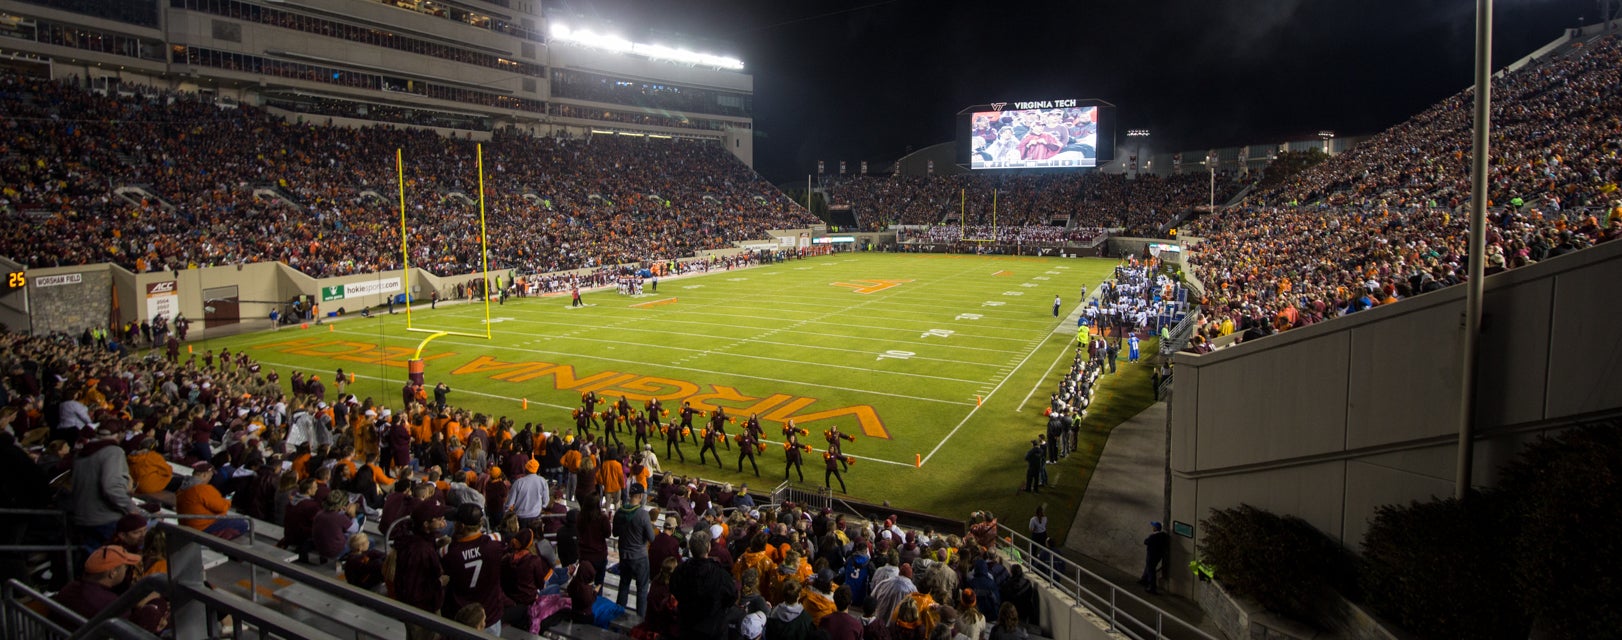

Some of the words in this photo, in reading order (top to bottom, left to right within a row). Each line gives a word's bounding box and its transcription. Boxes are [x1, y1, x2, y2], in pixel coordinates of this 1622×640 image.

[1014, 101, 1053, 110] VIRGINIA
[1054, 99, 1077, 108] TECH
[9, 271, 26, 288] 25
[37, 275, 65, 286] WORSHAM
[66, 274, 80, 283] FIELD
[150, 281, 174, 293] ACC
[347, 281, 398, 295] hokiesports.com
[876, 350, 916, 361] 10
[449, 355, 894, 440] VIRGINIA
[462, 547, 481, 560] VICK
[464, 560, 483, 588] 7
